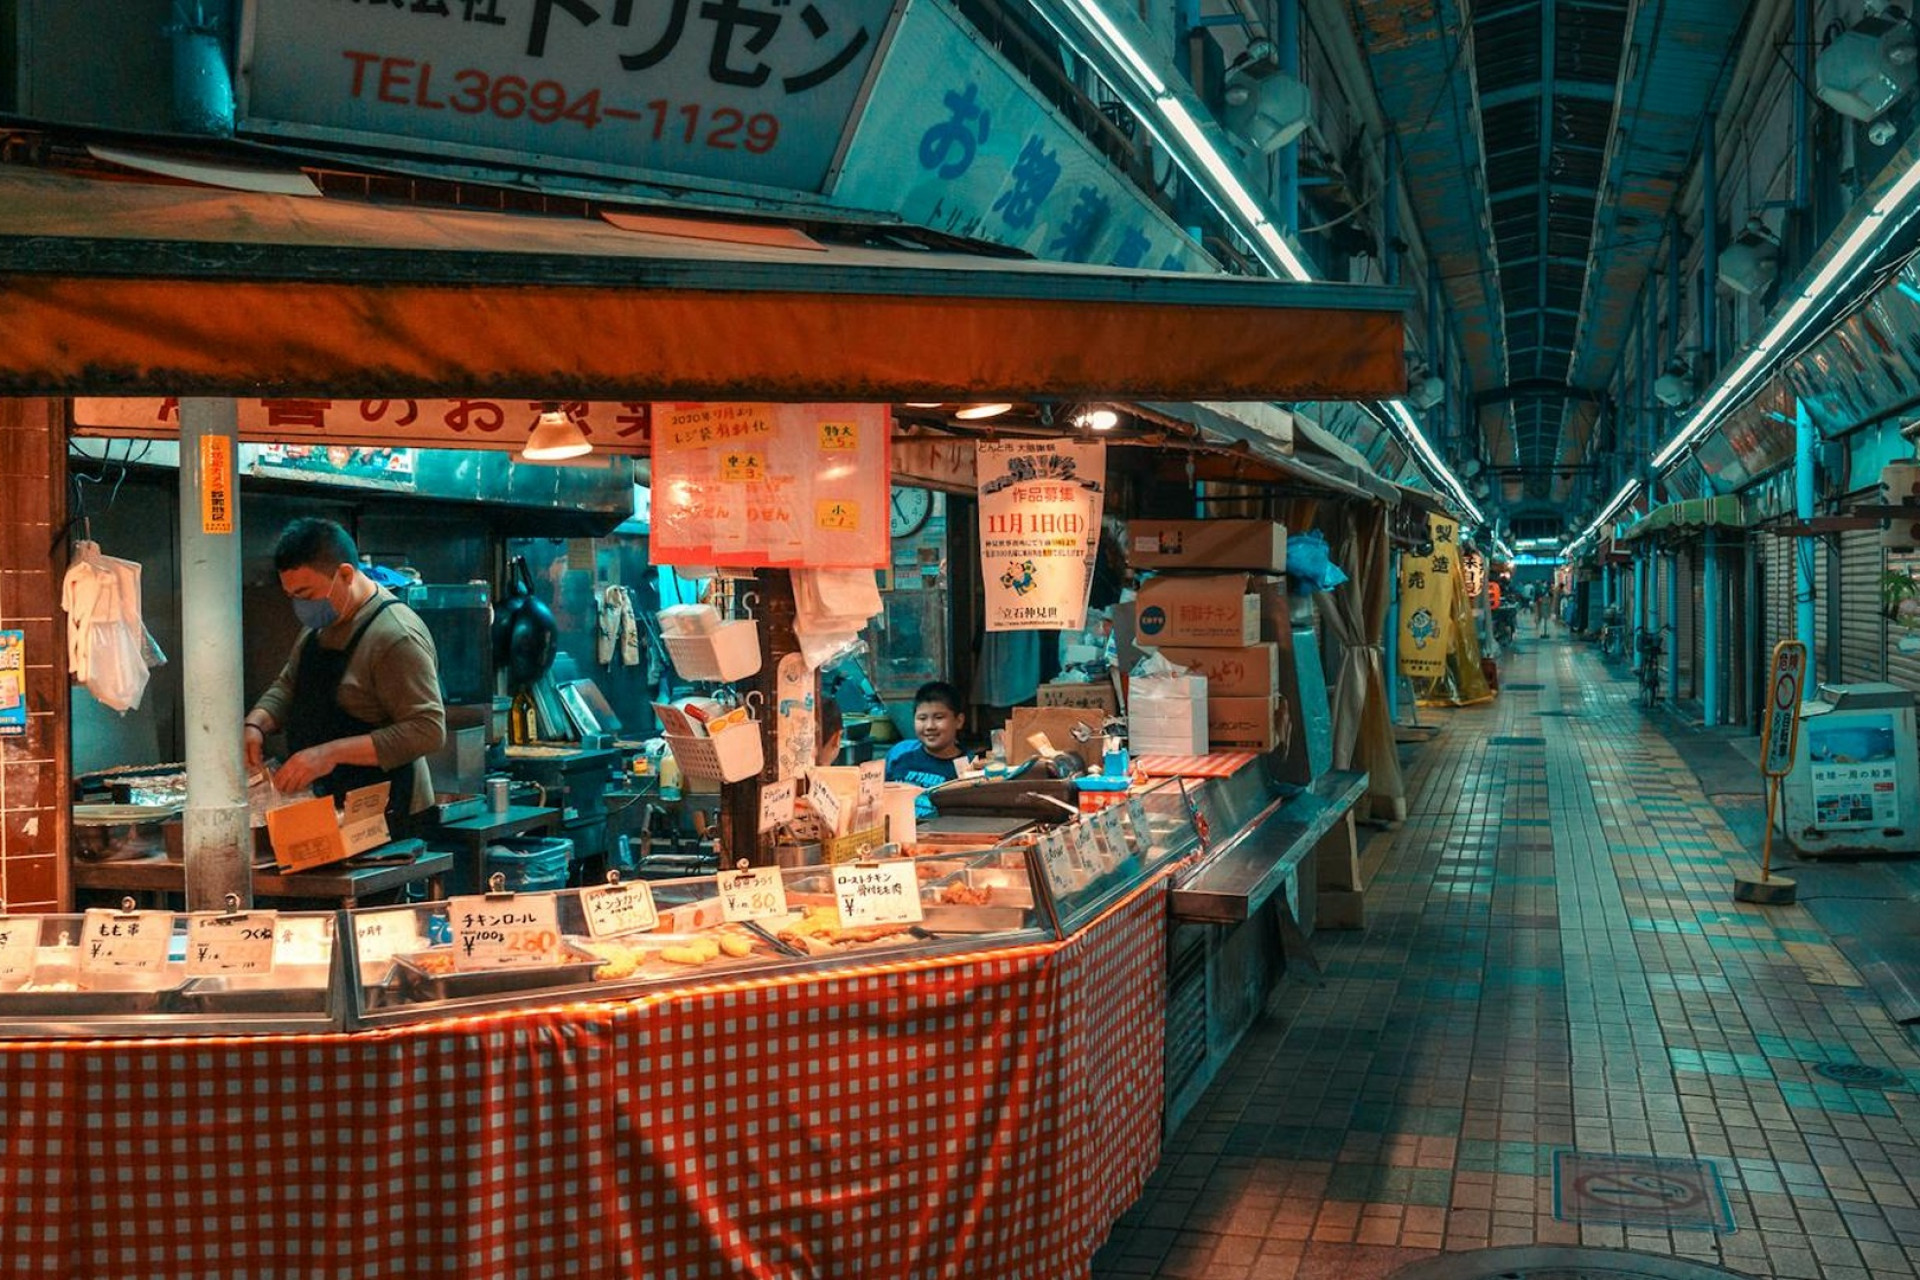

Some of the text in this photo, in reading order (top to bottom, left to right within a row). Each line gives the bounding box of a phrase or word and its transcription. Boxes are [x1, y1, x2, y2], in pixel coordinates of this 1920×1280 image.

[525, 0, 870, 95] トリゼン
[462, 913, 537, 929] チキンロール
